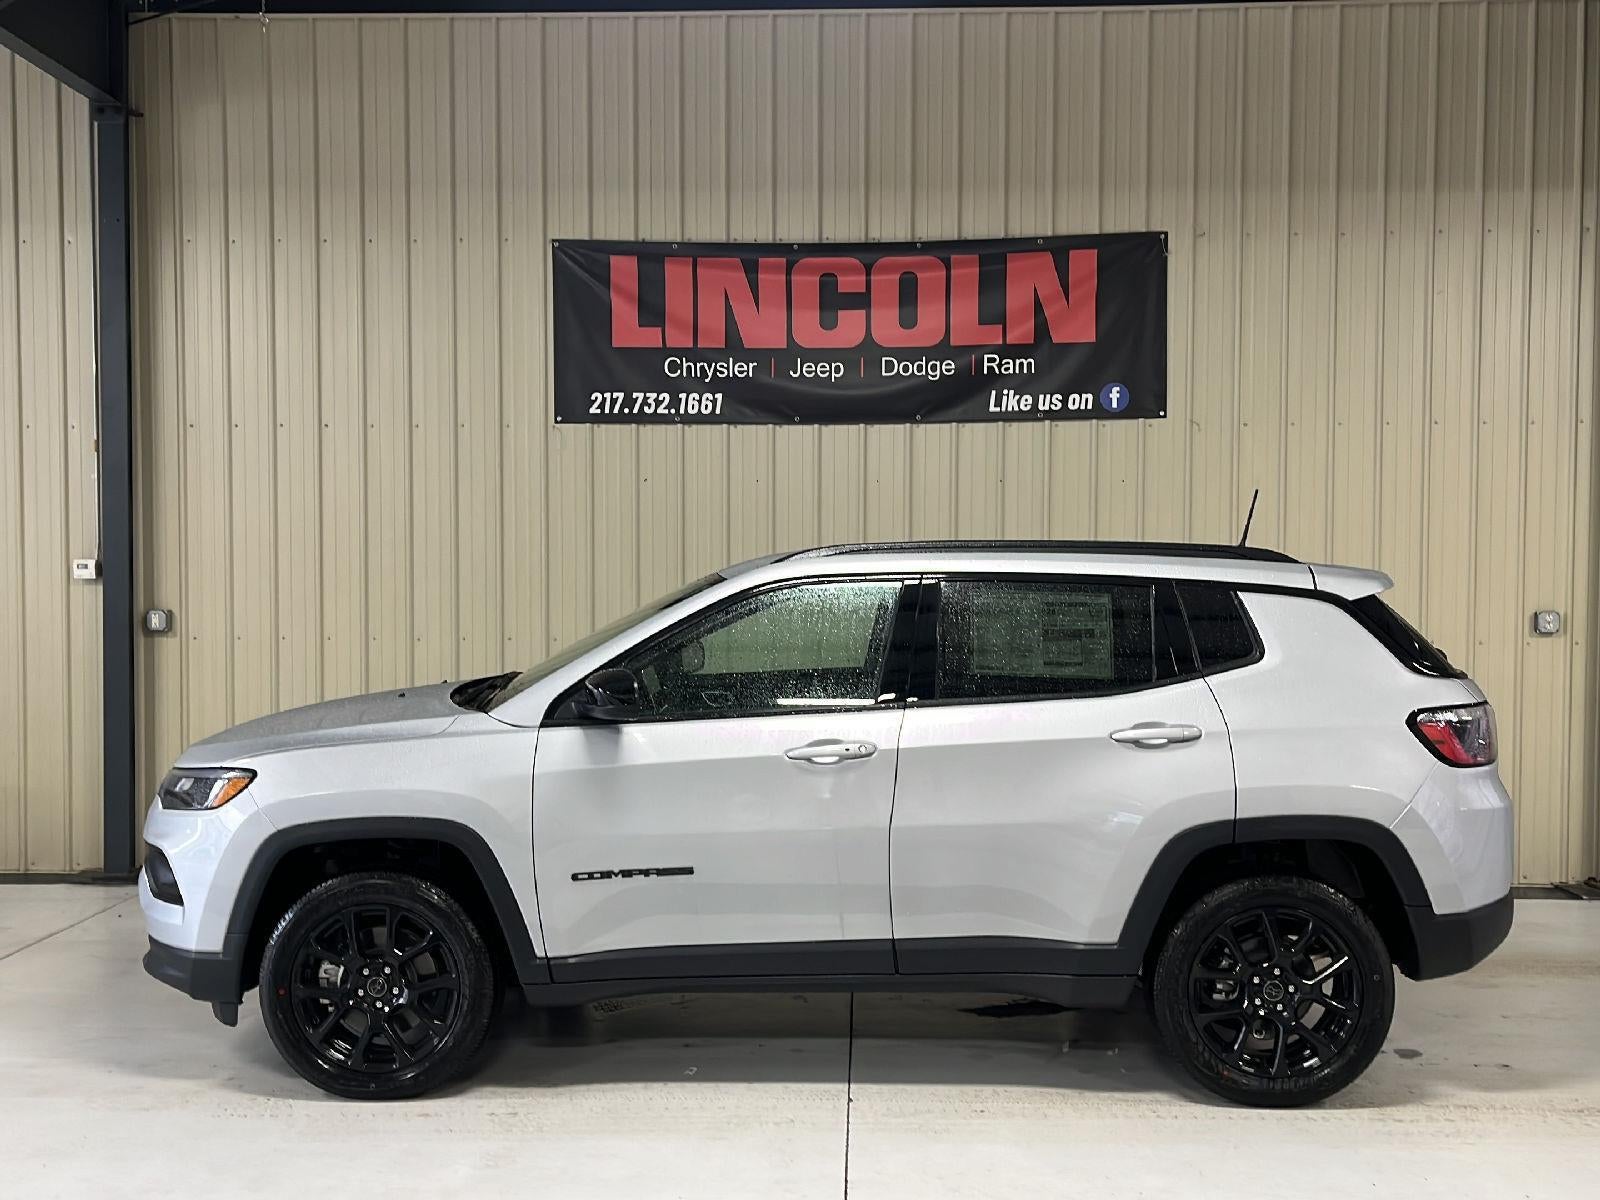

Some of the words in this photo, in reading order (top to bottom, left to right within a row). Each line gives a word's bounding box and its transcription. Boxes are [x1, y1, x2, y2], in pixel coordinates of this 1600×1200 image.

[610, 249, 1097, 348] LINCOLN
[664, 356, 758, 383] Chrysler
[789, 357, 845, 383] Jeep
[881, 355, 956, 381] Dodge
[983, 353, 1035, 375] Ram
[588, 391, 724, 415] 217.732.1661
[988, 388, 1033, 413] Like
[1037, 393, 1063, 412] us
[1067, 392, 1094, 411] on
[570, 866, 695, 882] COMPA
